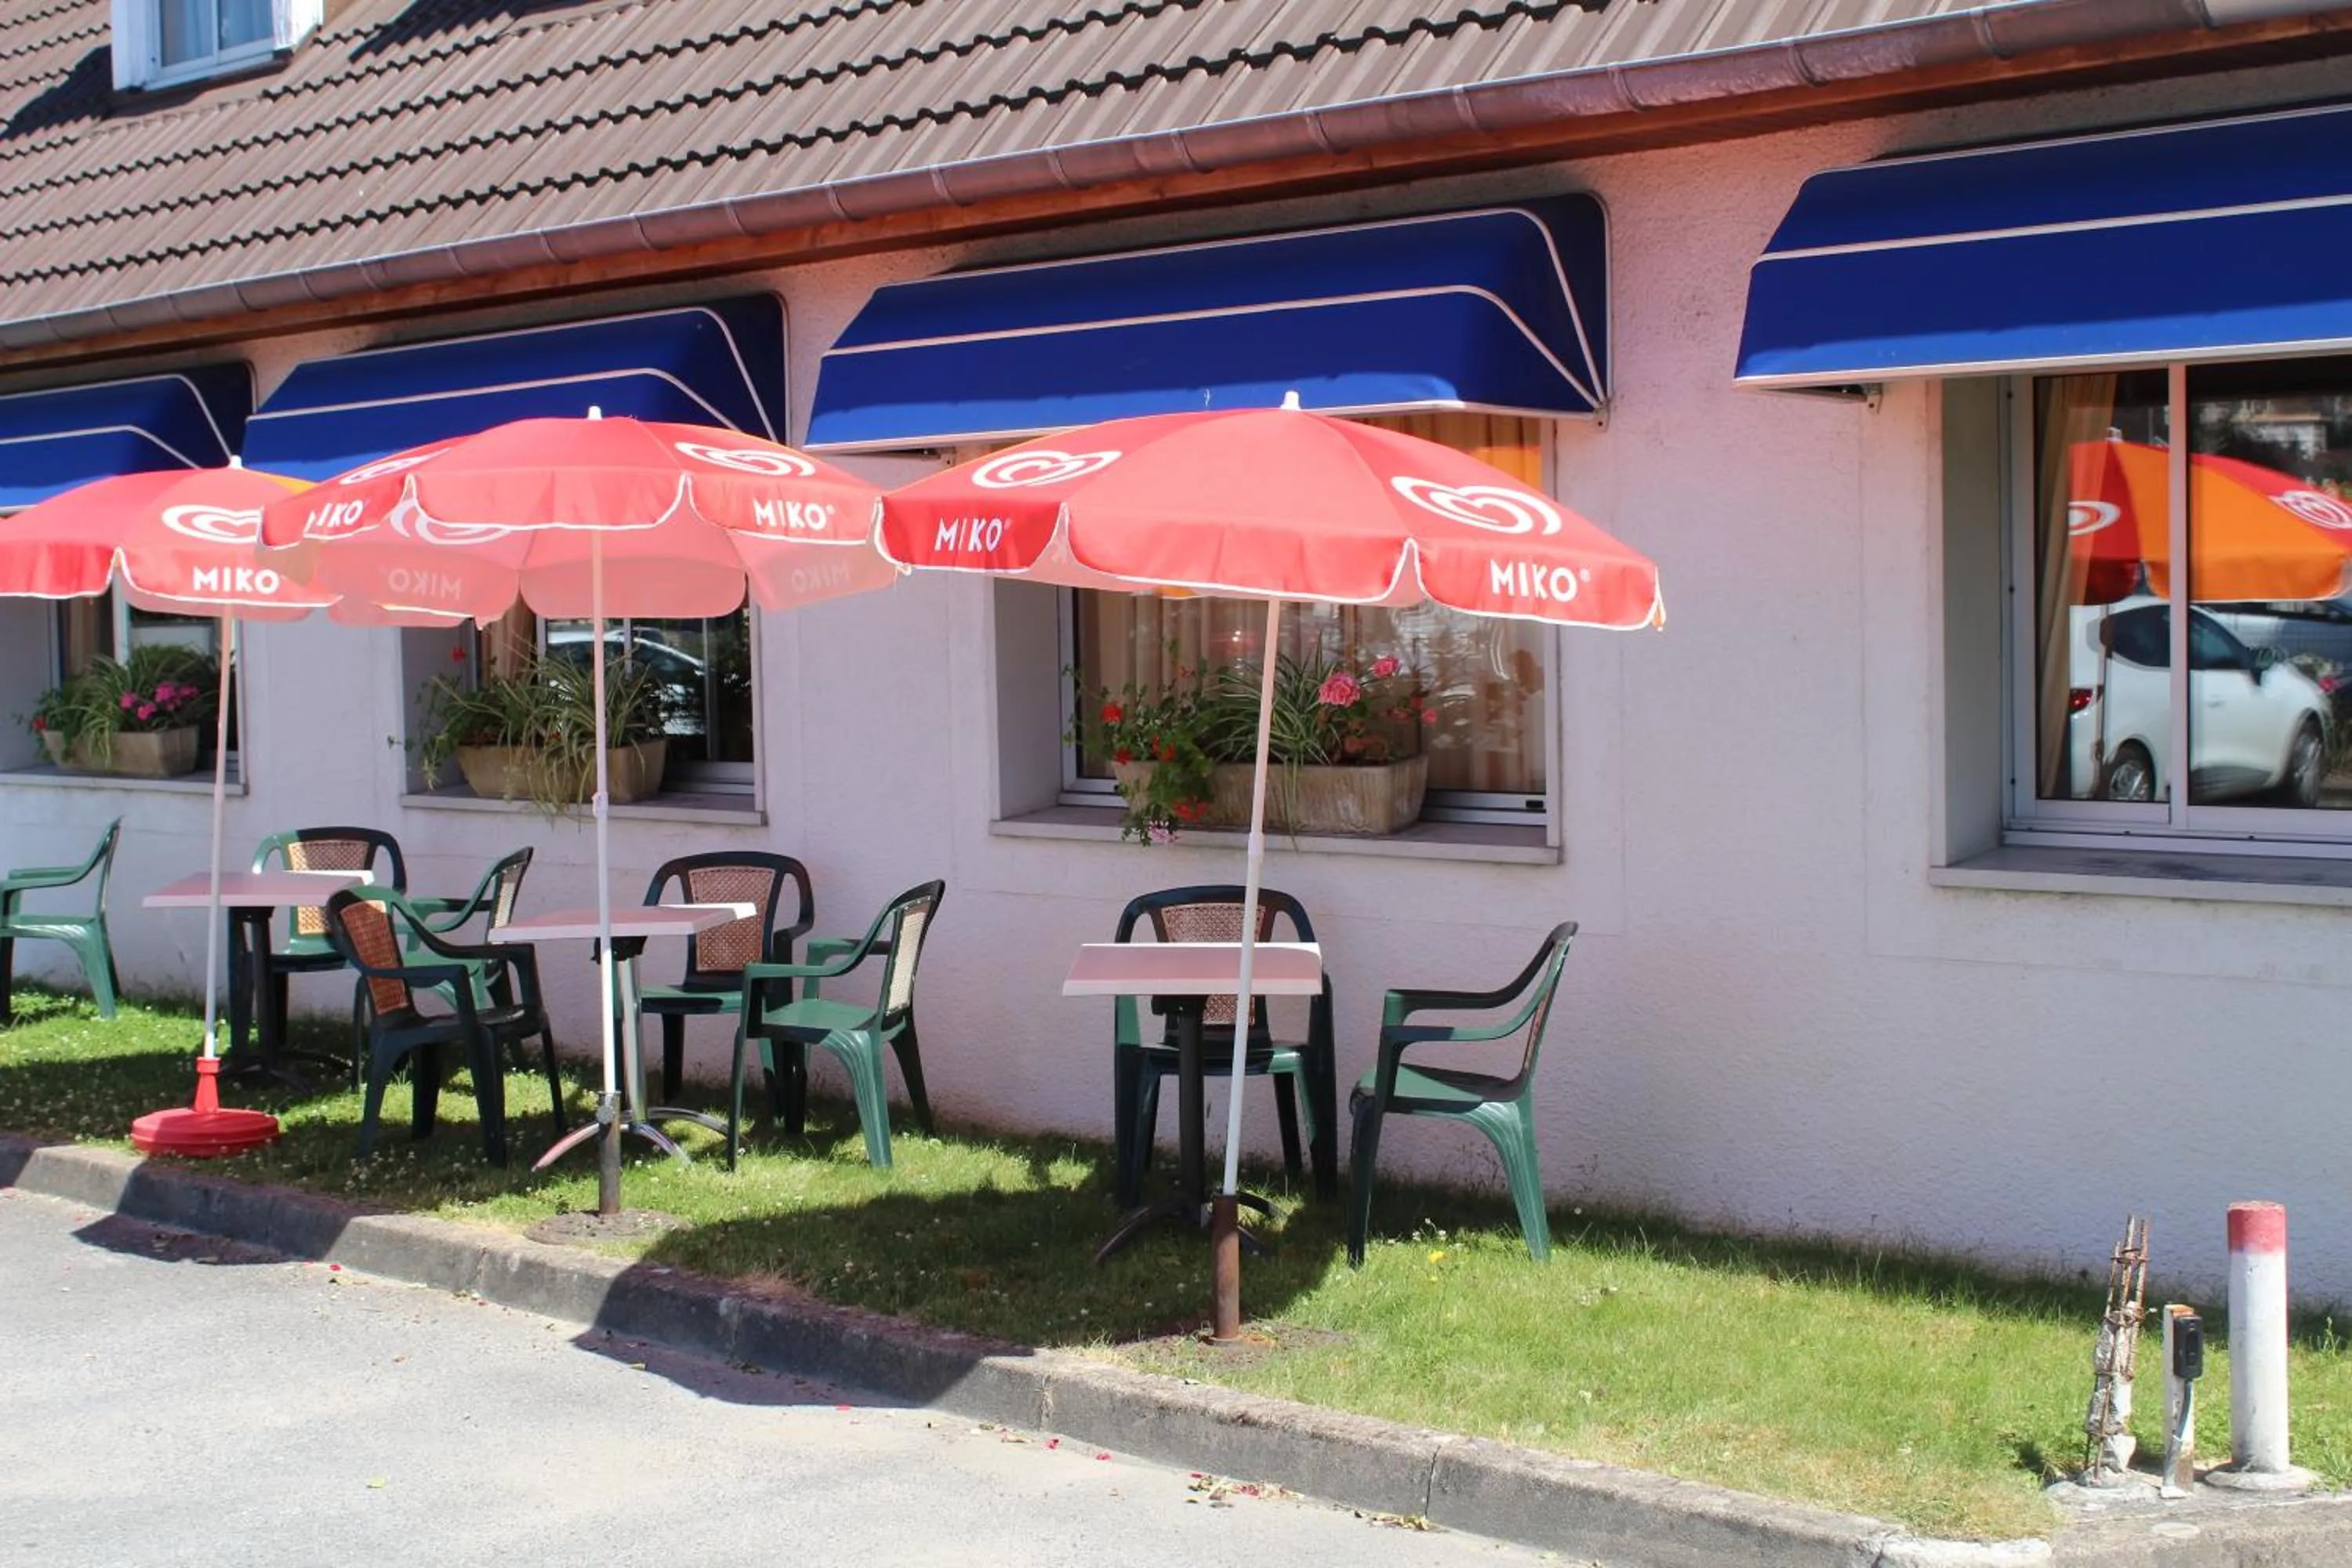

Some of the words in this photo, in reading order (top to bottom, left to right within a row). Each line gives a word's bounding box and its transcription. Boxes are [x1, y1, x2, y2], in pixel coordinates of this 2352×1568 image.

[753, 497, 827, 530] MIKO
[934, 517, 1004, 552] MIKO
[192, 565, 280, 594] MIKO
[1490, 559, 1578, 602] MIKO
